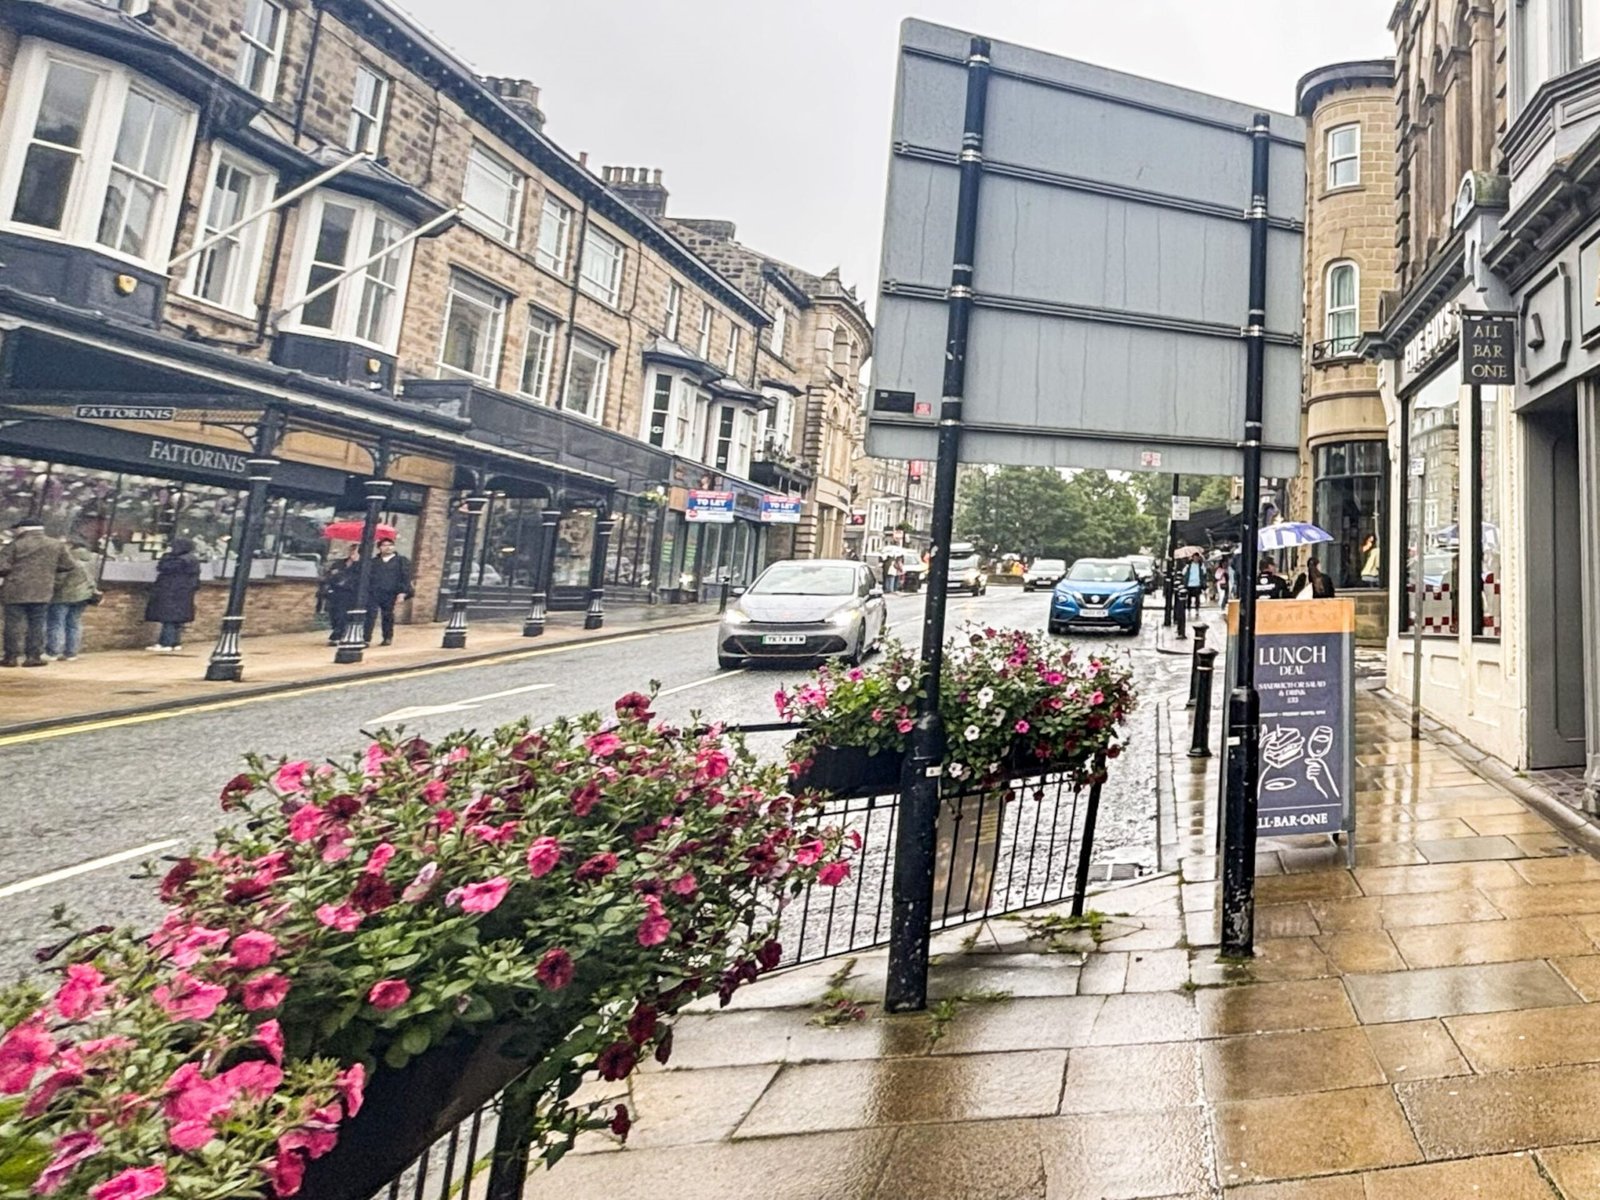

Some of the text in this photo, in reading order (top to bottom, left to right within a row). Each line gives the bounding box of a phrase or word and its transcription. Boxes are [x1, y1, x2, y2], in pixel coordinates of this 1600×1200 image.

[1472, 325, 1502, 338] ALL
[1472, 344, 1505, 358] BAR
[1471, 363, 1508, 378] ONE
[79, 406, 172, 419] FATTORINIS
[149, 440, 247, 472] FATTORINIS
[710, 499, 727, 507] LET
[1259, 646, 1326, 665] LUNCH
[1279, 665, 1306, 676] DEAL
[1258, 681, 1294, 691] SANDWICH
[1278, 689, 1285, 697] &
